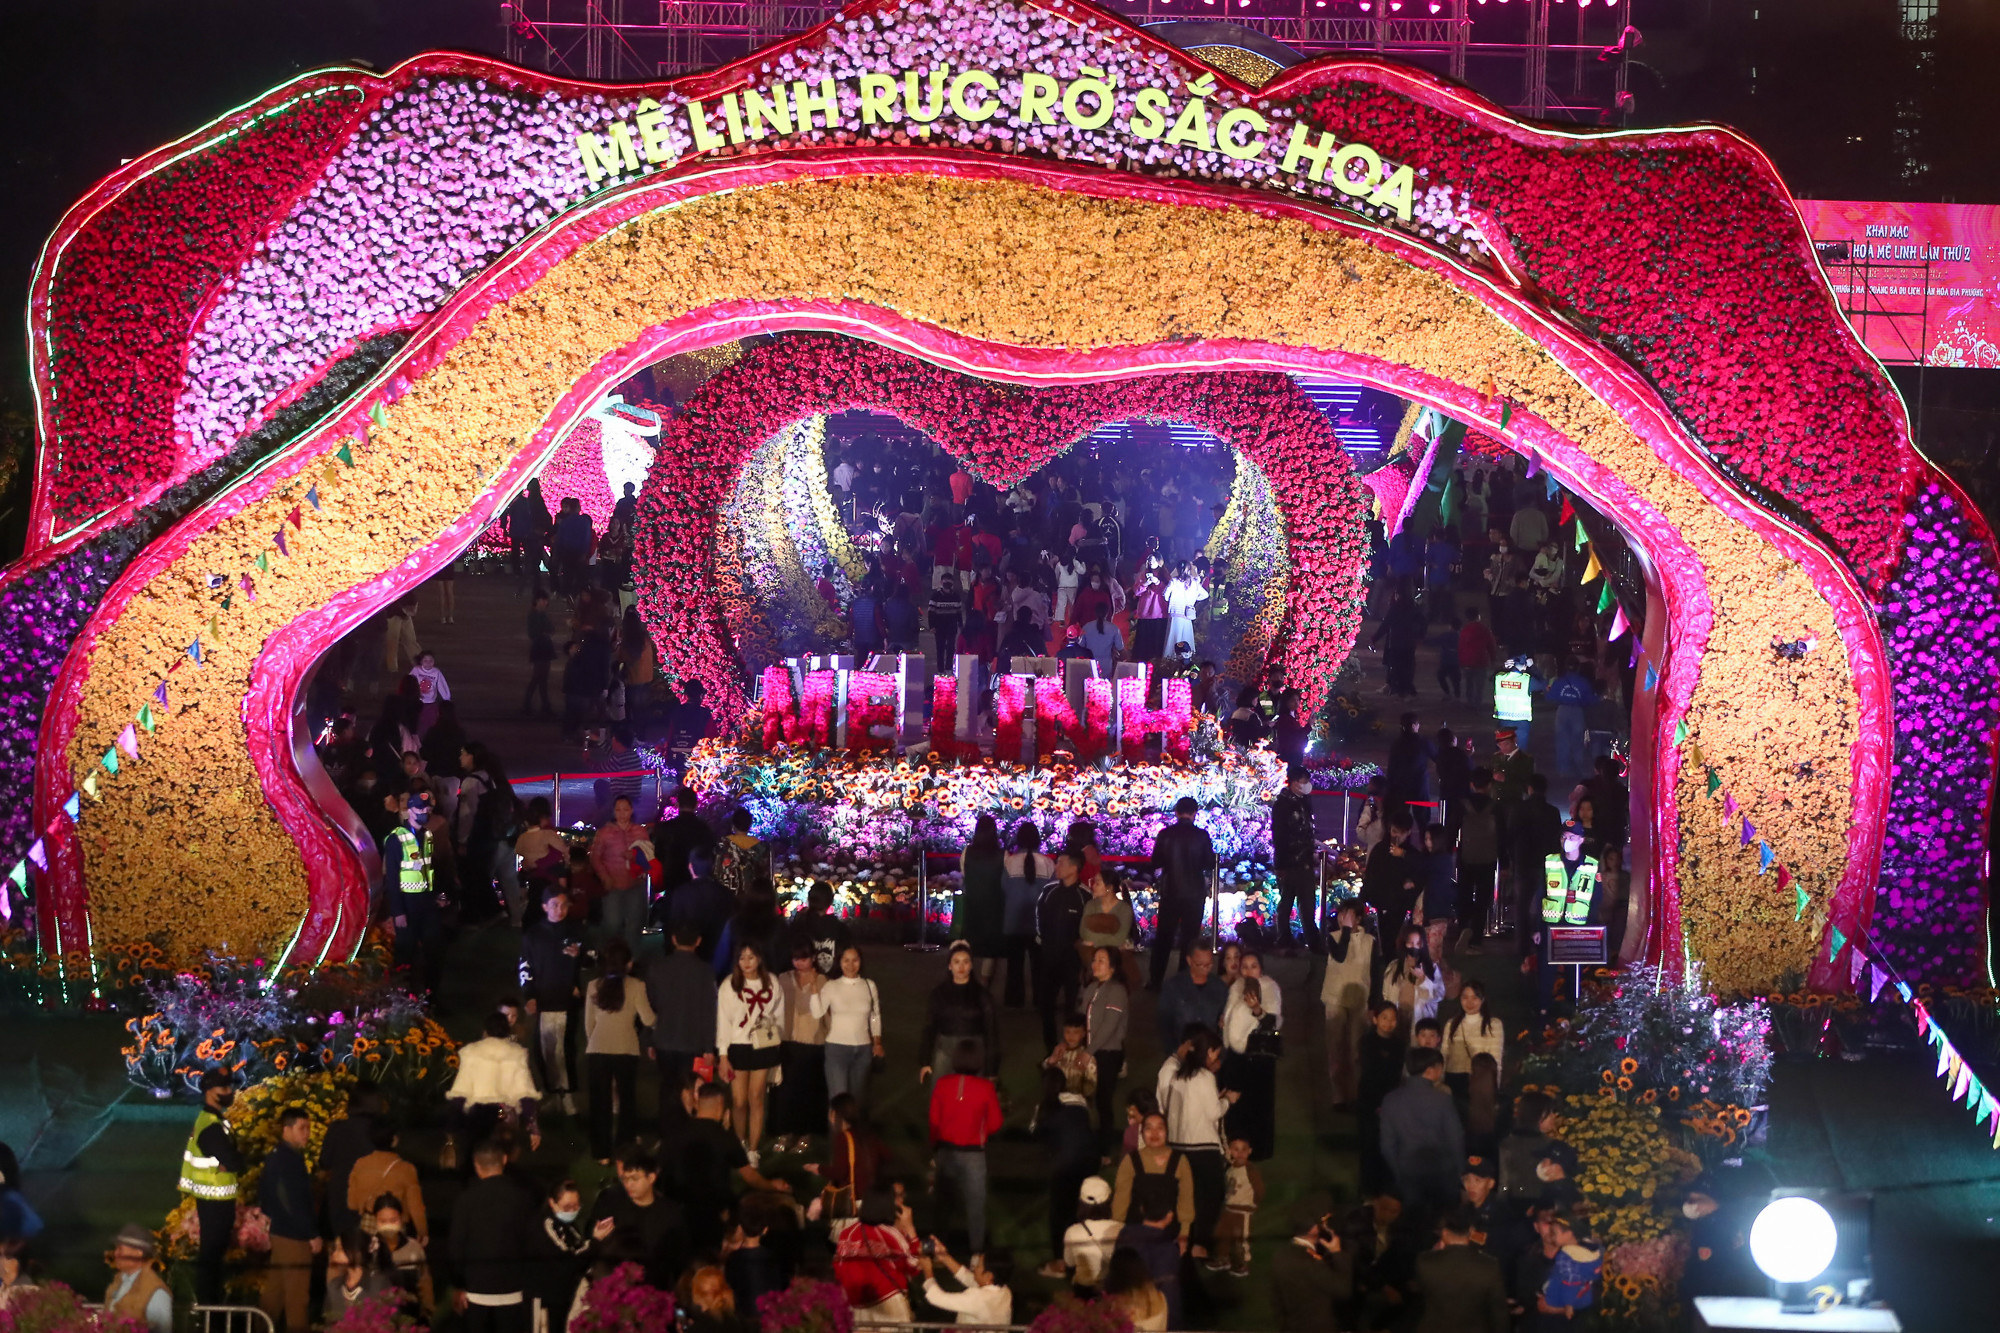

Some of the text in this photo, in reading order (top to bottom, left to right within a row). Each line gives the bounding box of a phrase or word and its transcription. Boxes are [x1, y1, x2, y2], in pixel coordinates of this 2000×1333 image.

[576, 63, 1414, 221] MÊ LINH RỰC RỠ SẮC HOA
[1866, 225, 1888, 237] KHAI
[1853, 244, 1874, 259] HOA
[1877, 242, 1892, 259] MÊ
[1894, 245, 1917, 260] LINH
[1964, 246, 1971, 261] 2
